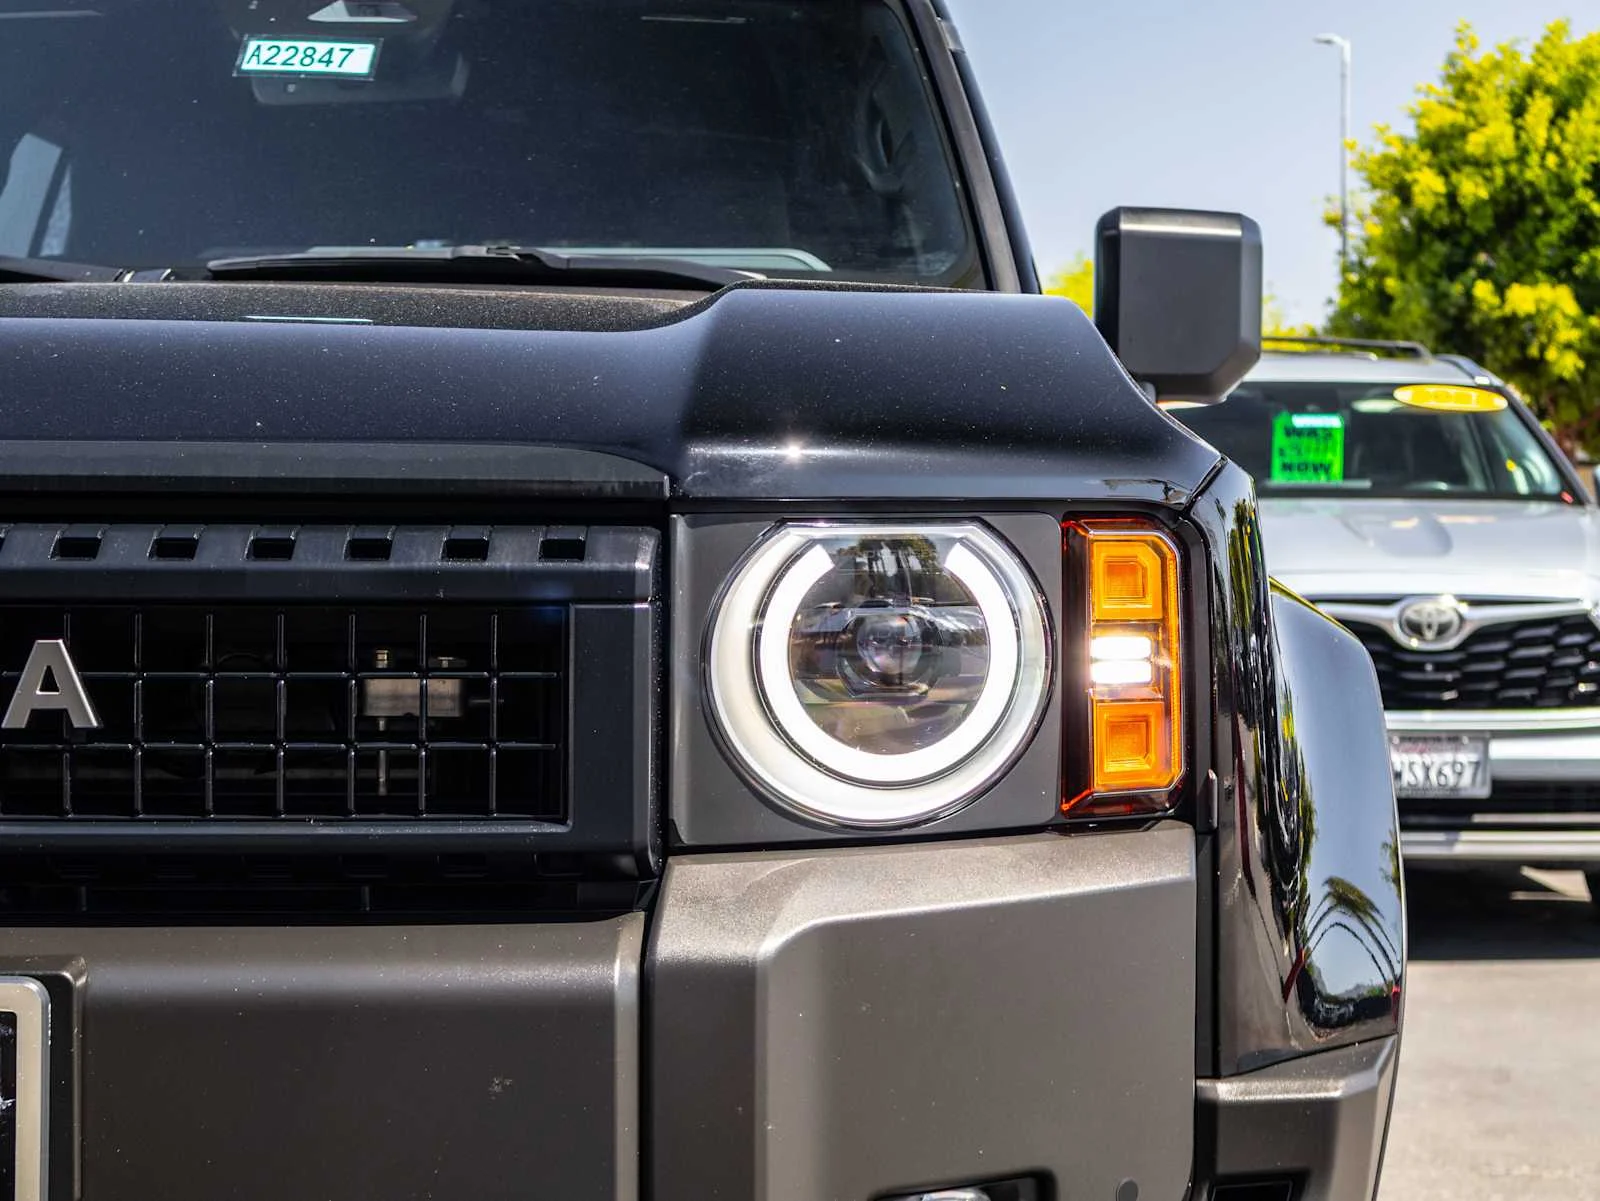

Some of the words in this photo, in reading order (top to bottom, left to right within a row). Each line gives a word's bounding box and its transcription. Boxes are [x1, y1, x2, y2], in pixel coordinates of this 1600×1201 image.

[246, 44, 355, 68] A22847
[1281, 462, 1332, 476] NOW
[1, 639, 99, 728] A
